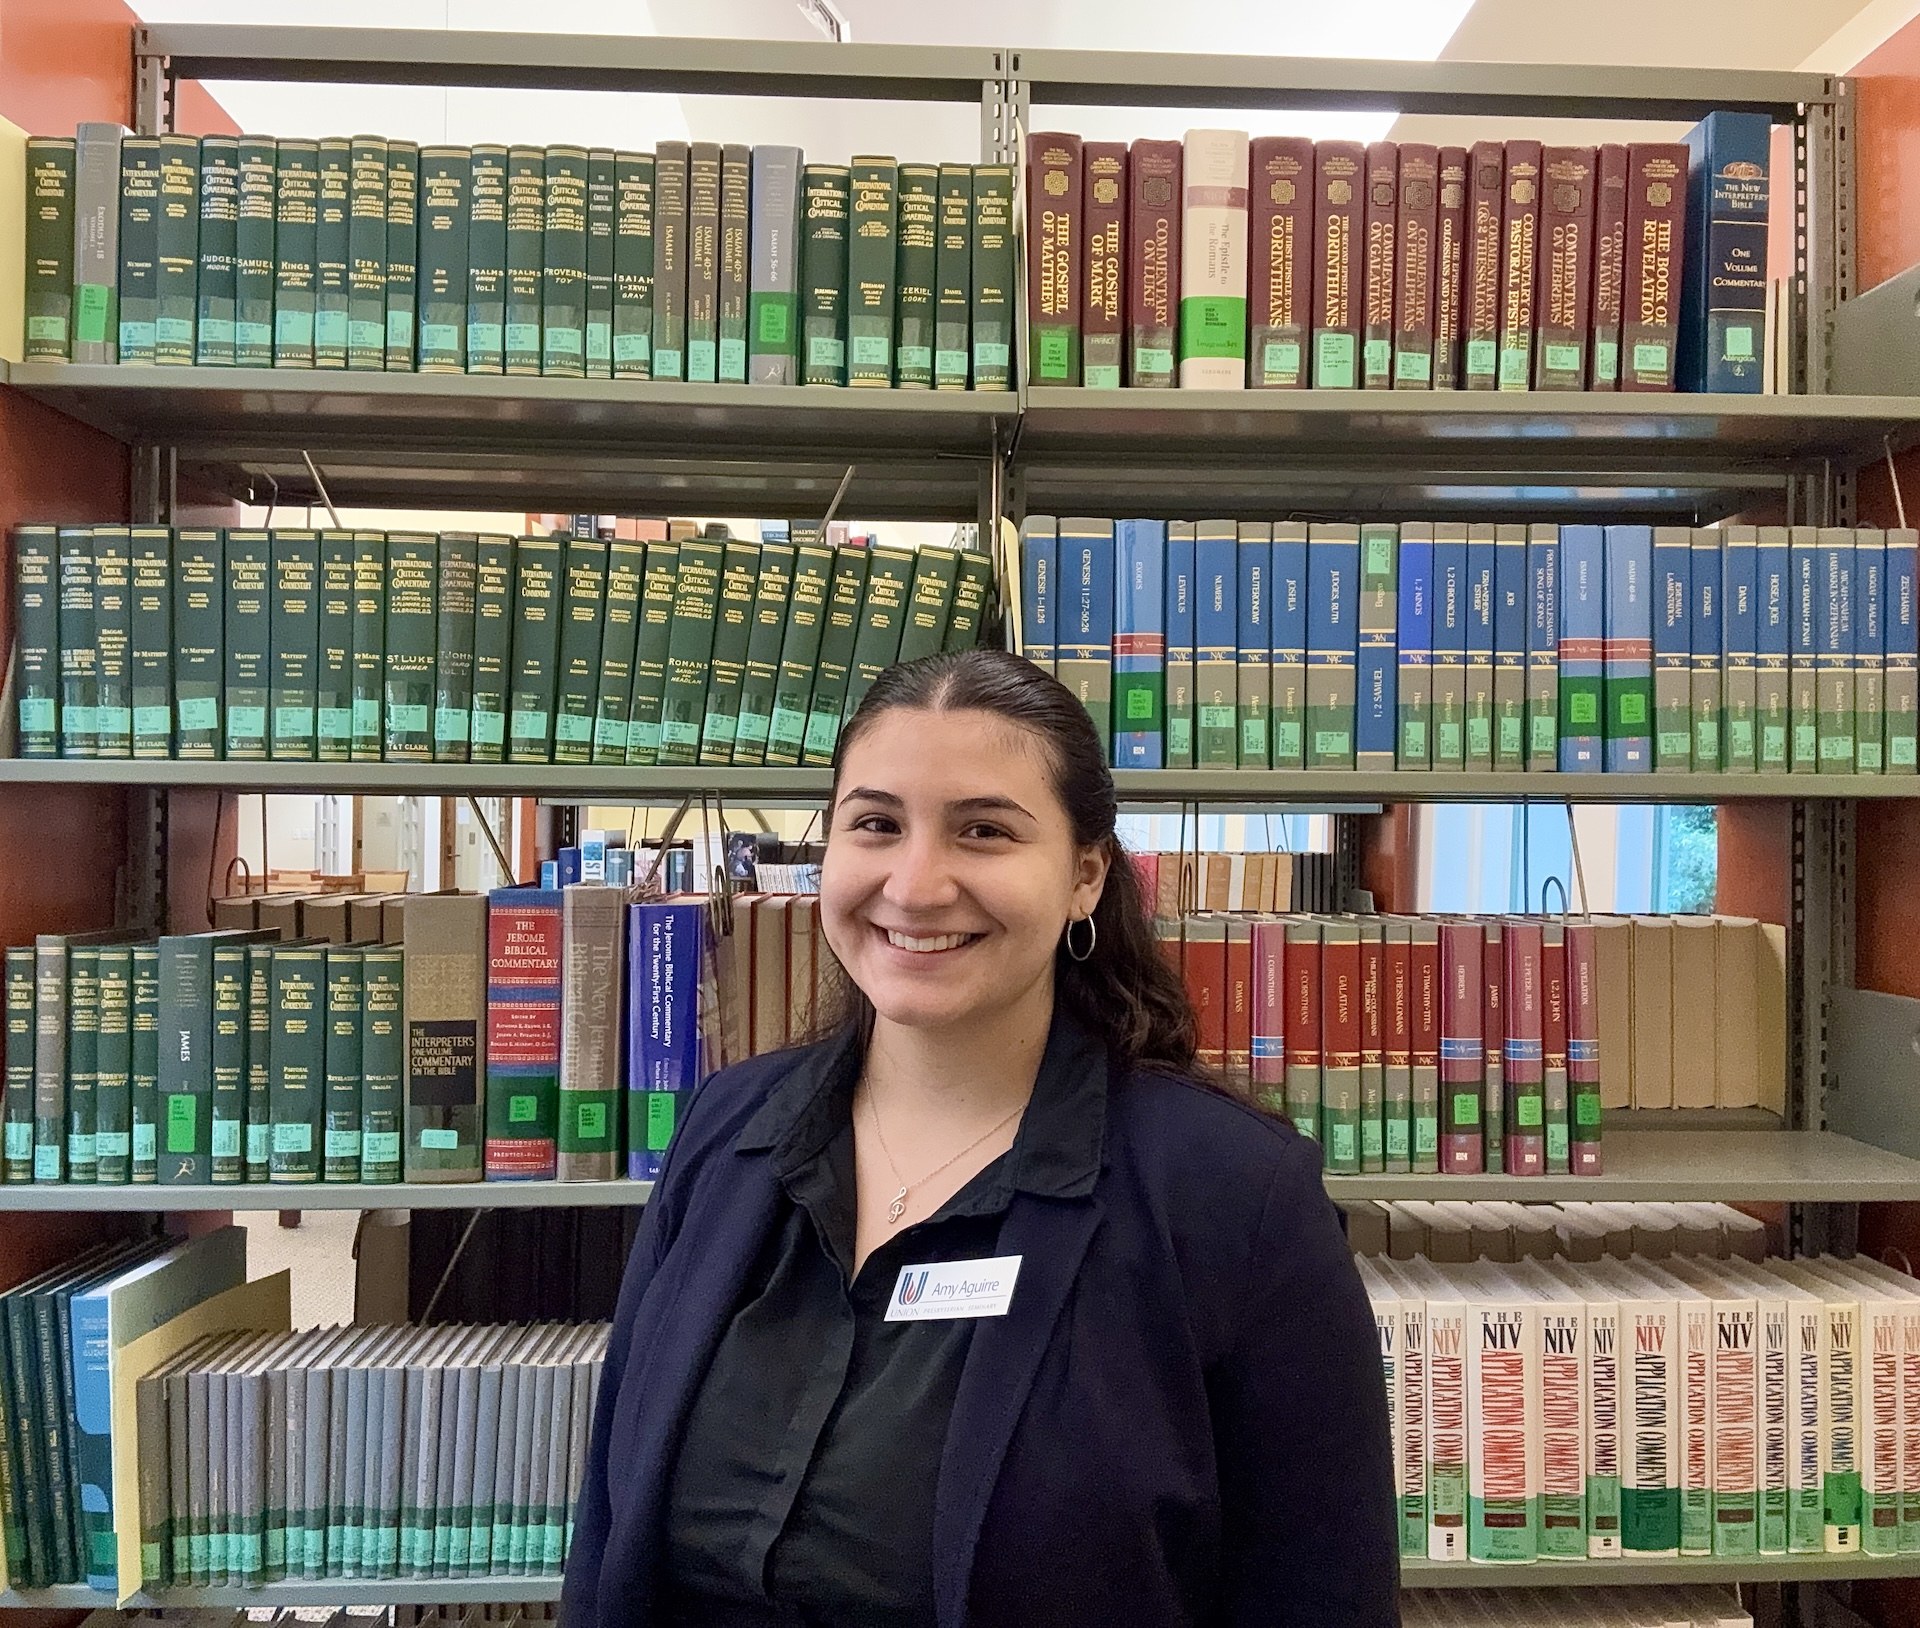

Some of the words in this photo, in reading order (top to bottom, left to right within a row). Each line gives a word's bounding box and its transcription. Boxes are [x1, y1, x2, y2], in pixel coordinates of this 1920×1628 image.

[548, 195, 584, 207] COMMENTARY
[552, 185, 579, 195] CRITICAL
[1741, 184, 1760, 192] NEW
[808, 207, 848, 219] COMMENTARY
[812, 198, 843, 208] CRITICAL
[1731, 200, 1753, 209] BIBLE
[1043, 211, 1054, 233] OF
[1057, 213, 1069, 246] THE
[1221, 224, 1229, 238] The
[1370, 221, 1382, 242] ON
[1407, 220, 1418, 240] ON
[1658, 219, 1672, 253] THE
[665, 225, 673, 255] ISAIAH
[695, 225, 703, 258] VOLUME
[704, 226, 712, 256] ISAIAH
[725, 227, 733, 258] VOLUME
[734, 228, 743, 257] ISAIAH
[770, 229, 778, 257] ISAIAH
[1092, 235, 1103, 256] OF
[1106, 221, 1119, 253] THE
[1144, 240, 1155, 260] ON
[1285, 236, 1293, 259] FIRST
[1442, 218, 1452, 278] COLOSSIANS
[1553, 227, 1564, 249] ON
[237, 259, 273, 268] SAMUEL
[281, 262, 310, 271] KINGS
[355, 259, 380, 269] EZRA
[1208, 239, 1218, 279] Romans
[1221, 241, 1229, 275] Epistle
[1452, 242, 1460, 263] THE
[1486, 217, 1498, 312] COMMENTARY
[1509, 219, 1522, 287] PASTORAL
[1521, 213, 1534, 307] COMMENTARY
[1732, 248, 1751, 257] ONE
[349, 273, 386, 283] NEHEMIAH
[470, 269, 503, 277] PSALMS
[508, 269, 541, 277] PSALMS
[544, 268, 587, 278] PROVERBS
[614, 274, 653, 284] ISAIAH
[1041, 237, 1054, 315] MATTHEW
[1156, 218, 1168, 327] COMMENTARY
[1270, 215, 1284, 328] CORINTHIANS
[1326, 215, 1340, 327] CORINTHIANS
[1382, 223, 1394, 321] COMMENTARY
[1415, 228, 1428, 325] COMMENTARY
[1563, 223, 1578, 330] COMMENTARY
[1641, 219, 1657, 326] REVELATION
[1656, 257, 1669, 303] BOOK
[1725, 262, 1758, 272] VOLUME
[1056, 251, 1069, 314] GOSPEL
[1091, 260, 1103, 308] MARK
[1105, 257, 1118, 321] GOSPEL
[1144, 265, 1155, 307] LUKE
[1369, 244, 1381, 325] GALATIANS
[1404, 243, 1417, 332] PHILIPPIANS
[1441, 278, 1450, 297] AND
[1452, 264, 1460, 307] EPISTLES
[1551, 252, 1563, 324] HEBREWS
[1599, 260, 1612, 311] JAMES
[1285, 297, 1291, 309] TO
[1341, 299, 1347, 309] TO
[1519, 307, 1530, 327] ON
[1655, 307, 1667, 327] OF
[1485, 313, 1495, 332] ON
[1507, 291, 1519, 350] EPISTLES
[1440, 314, 1448, 364] PHILEMON
[1721, 354, 1756, 362] Abingdon
[390, 558, 432, 570] INTERNATIONAL
[396, 569, 425, 578] CRITICAL
[1038, 560, 1046, 595] GENESIS
[1082, 549, 1091, 584] GENESIS
[392, 578, 431, 588] COMMENTARY
[1178, 575, 1186, 613] LEVITICUS
[1252, 567, 1260, 625] DEUTERONOMY
[1287, 580, 1296, 612] JOSHUA
[1447, 580, 1455, 628] CHRONICLES
[1738, 586, 1747, 615] DANIEL
[1901, 575, 1910, 624] ZECHARIAH
[386, 655, 400, 663] ST
[402, 655, 434, 663] LUKE
[668, 657, 708, 670] ROMANS
[1374, 667, 1383, 703] SAMUEL
[516, 922, 535, 931] THE
[653, 923, 661, 933] for
[664, 915, 674, 930] The
[504, 946, 548, 955] BIBLICAL
[506, 933, 545, 942] JEROME
[653, 934, 661, 951] the
[665, 932, 674, 962] Jerome
[491, 959, 558, 968] COMMENTARY
[651, 953, 661, 1003] Twenty-First
[665, 964, 673, 993] Biblical
[1267, 960, 1275, 1008] CORINTHIANS
[1581, 963, 1589, 1006] REVELATION
[1339, 976, 1347, 1024] GALATIANS
[1490, 985, 1498, 1009] JAMES
[651, 1005, 661, 1040] Century
[663, 995, 674, 1048] Commentary
[179, 1030, 191, 1063] JAMES
[412, 1037, 474, 1047] INTERPRETER'S
[412, 1056, 473, 1067] COMMENTARY
[424, 1067, 436, 1075] THE
[438, 1067, 456, 1075] BIBLE
[932, 1282, 959, 1298] Amy
[959, 1278, 999, 1297] Aguirre
[890, 1308, 920, 1317] UNION
[1405, 1312, 1423, 1322] THE
[1481, 1312, 1522, 1322] THE
[1543, 1317, 1578, 1327] THE
[1635, 1315, 1666, 1325] THE
[1717, 1312, 1753, 1323] THE
[1766, 1312, 1784, 1323] THE
[1405, 1324, 1423, 1349] NIV
[1482, 1323, 1521, 1349] NIV
[1544, 1328, 1577, 1354] NIV
[1636, 1327, 1666, 1351] NIV
[1717, 1324, 1753, 1349] NIV
[1766, 1324, 1784, 1349] NIV
[1405, 1350, 1423, 1425] APPLICATION
[1482, 1350, 1524, 1426] APPLICATION
[1543, 1355, 1579, 1429] APPLICATION
[1766, 1350, 1784, 1424] APPLICATION
[1801, 1353, 1818, 1427] APPLICATION
[1405, 1430, 1423, 1512] COMMENTARY
[1483, 1429, 1526, 1511] COMMENTARY
[1543, 1432, 1580, 1513] COMMENTARY
[1766, 1427, 1785, 1508] COMMENTARY
[1801, 1431, 1819, 1509] COMMENTARY
